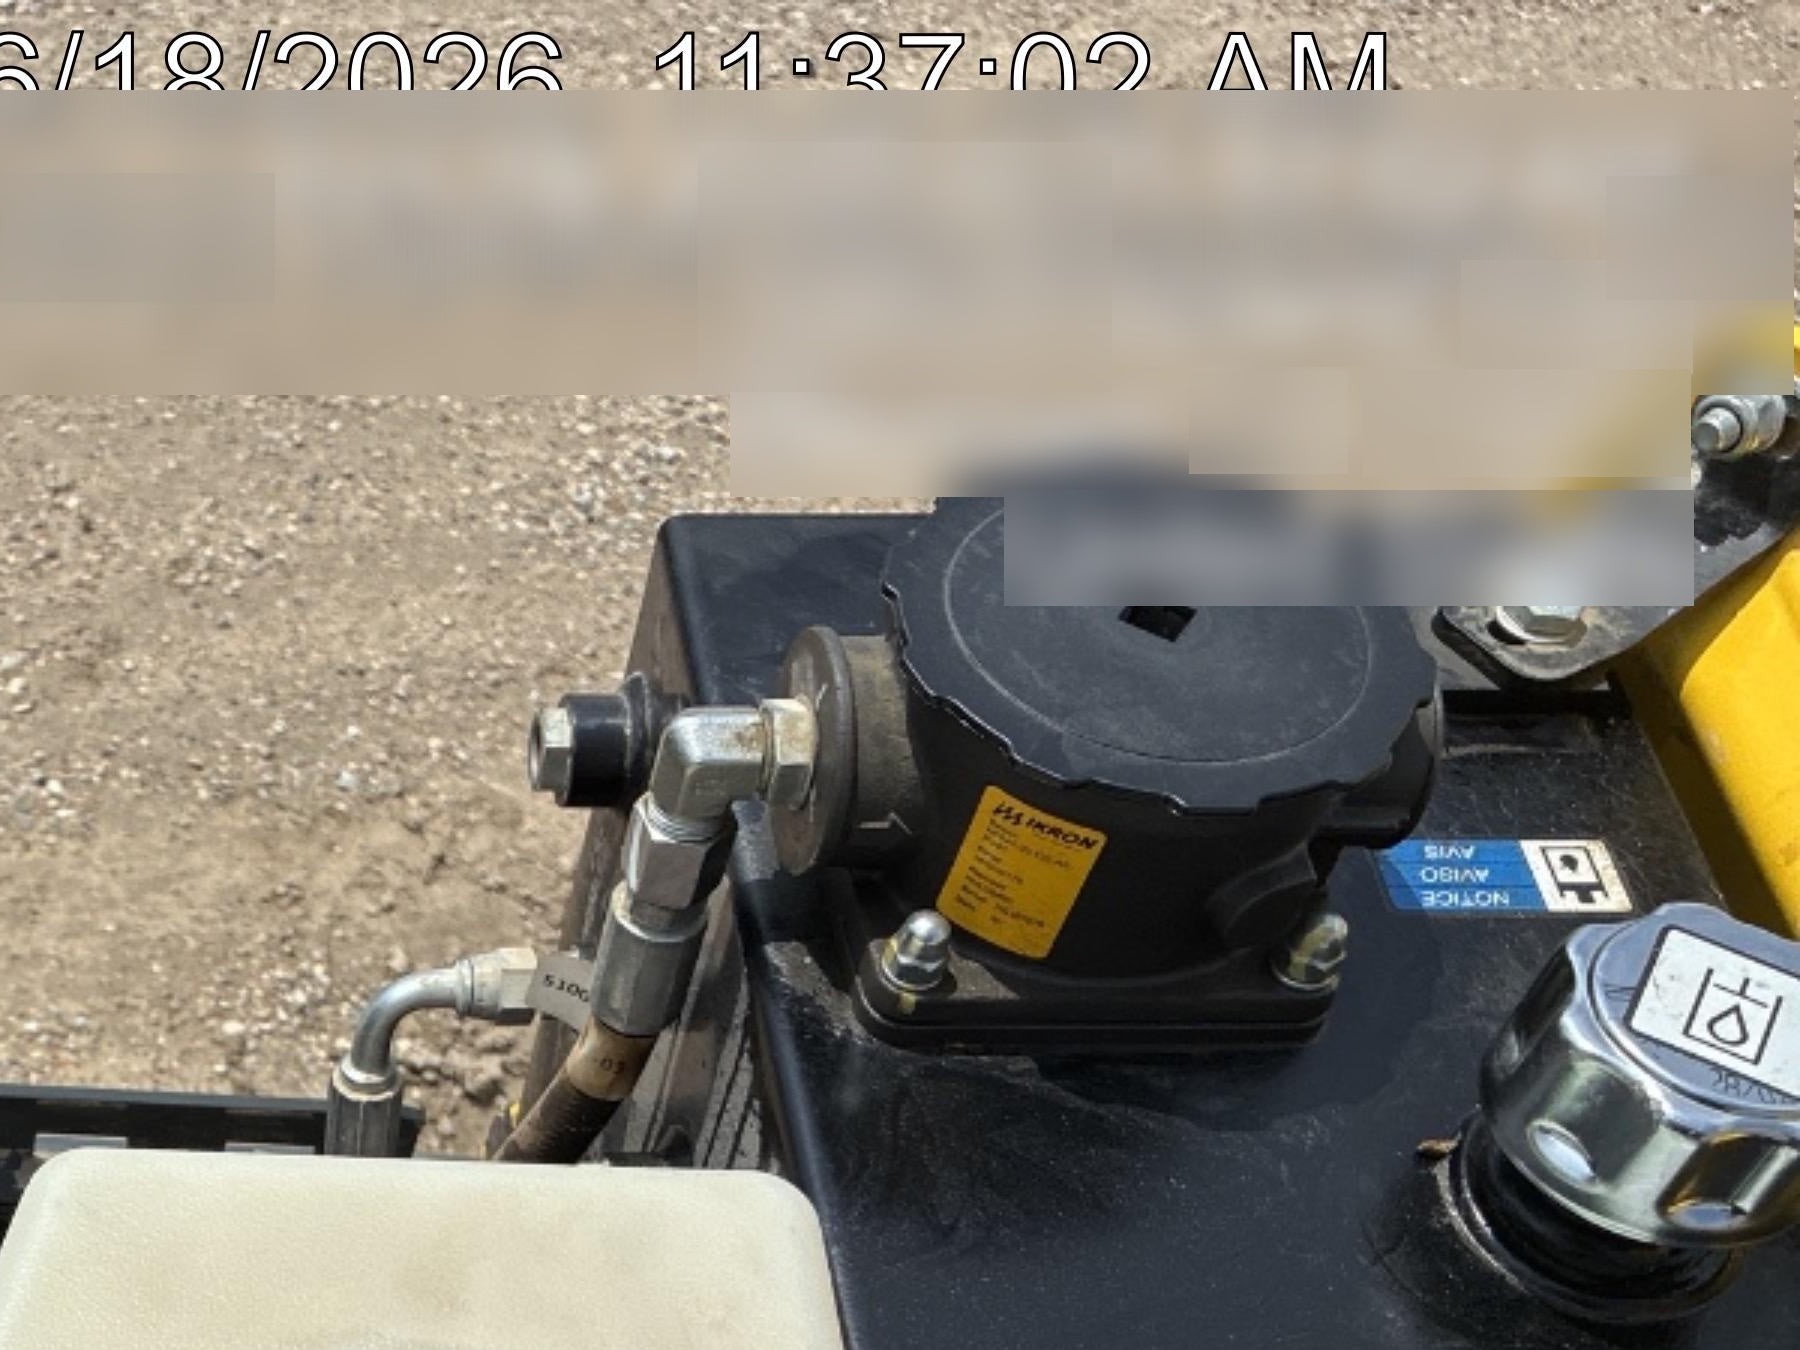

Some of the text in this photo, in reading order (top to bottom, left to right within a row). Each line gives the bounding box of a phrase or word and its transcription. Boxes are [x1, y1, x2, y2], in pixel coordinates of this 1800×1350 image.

[1424, 845, 1474, 859] AVIS
[1420, 867, 1489, 883] AVISO
[1420, 890, 1509, 907] NOTICE
